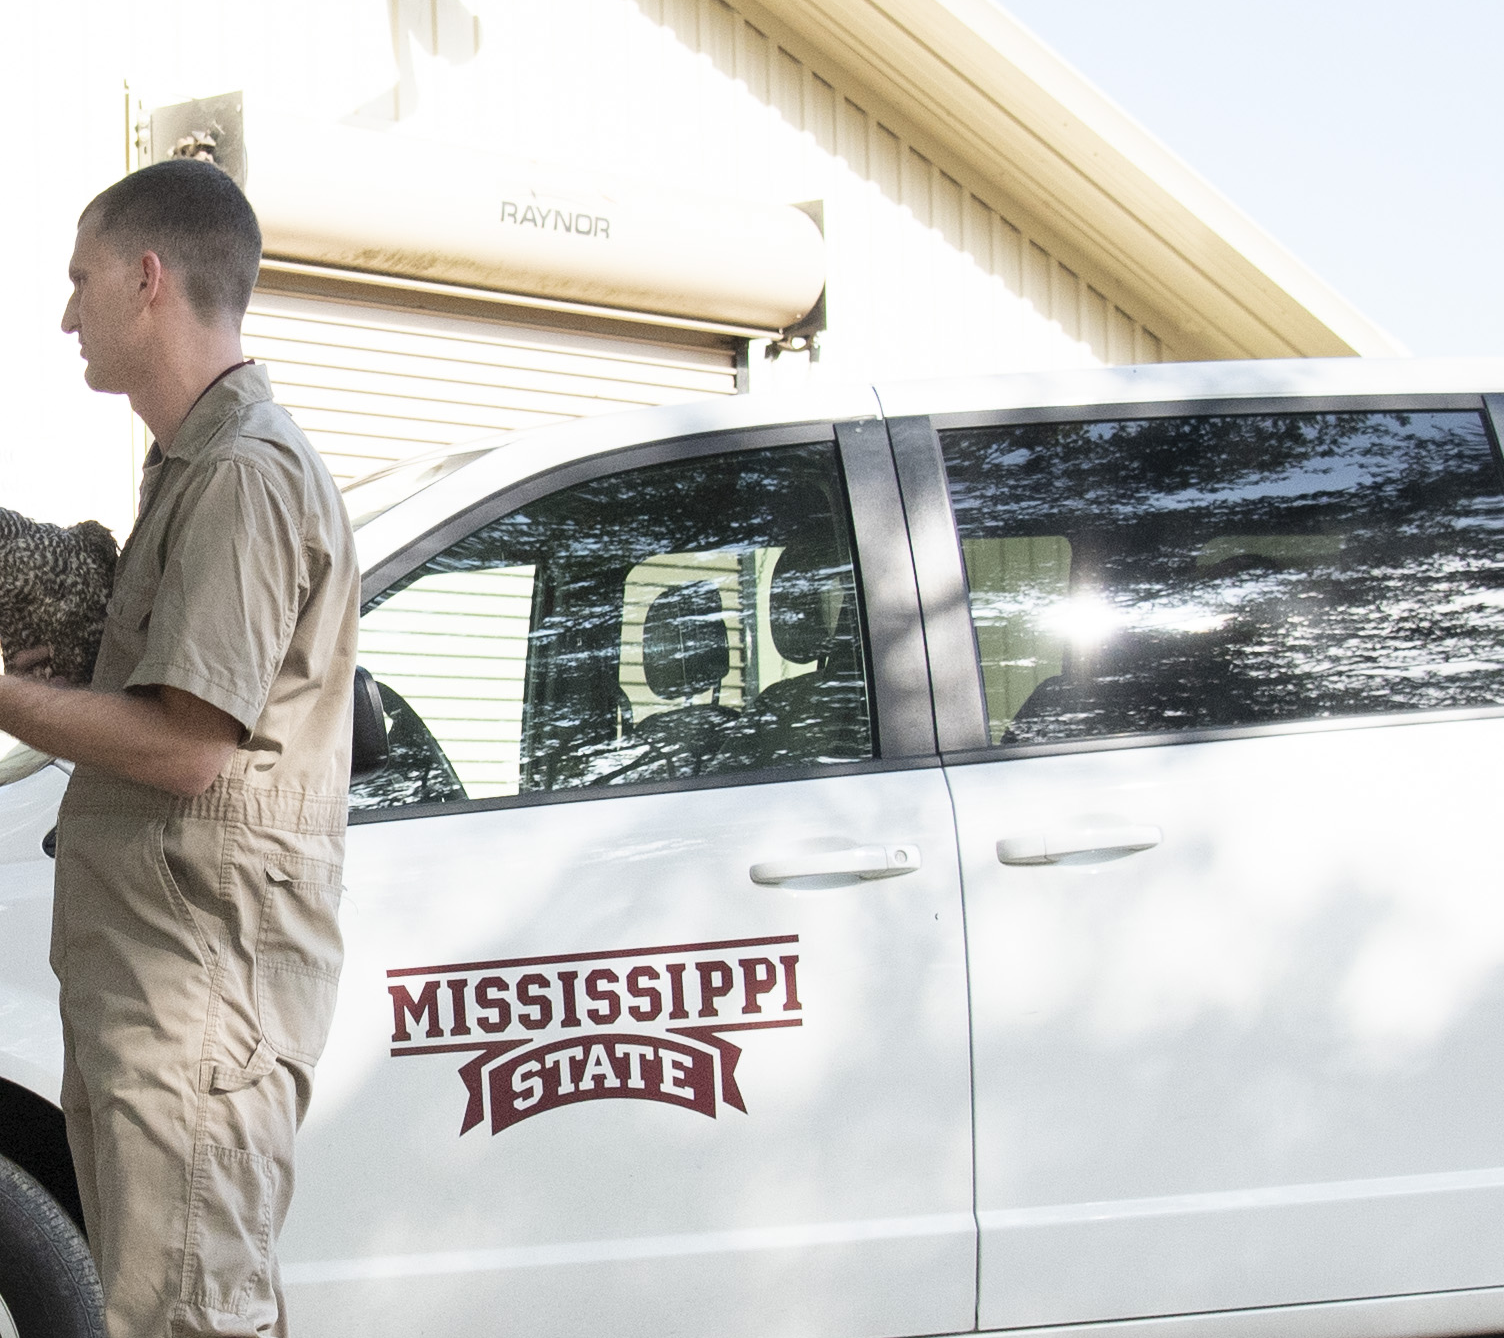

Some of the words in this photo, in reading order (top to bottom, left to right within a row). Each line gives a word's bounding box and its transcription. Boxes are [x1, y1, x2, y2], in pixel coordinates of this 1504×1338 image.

[500, 201, 611, 239] RAYNOR
[387, 954, 803, 1043] MISSISSIPPI
[510, 1043, 695, 1111] STATE
